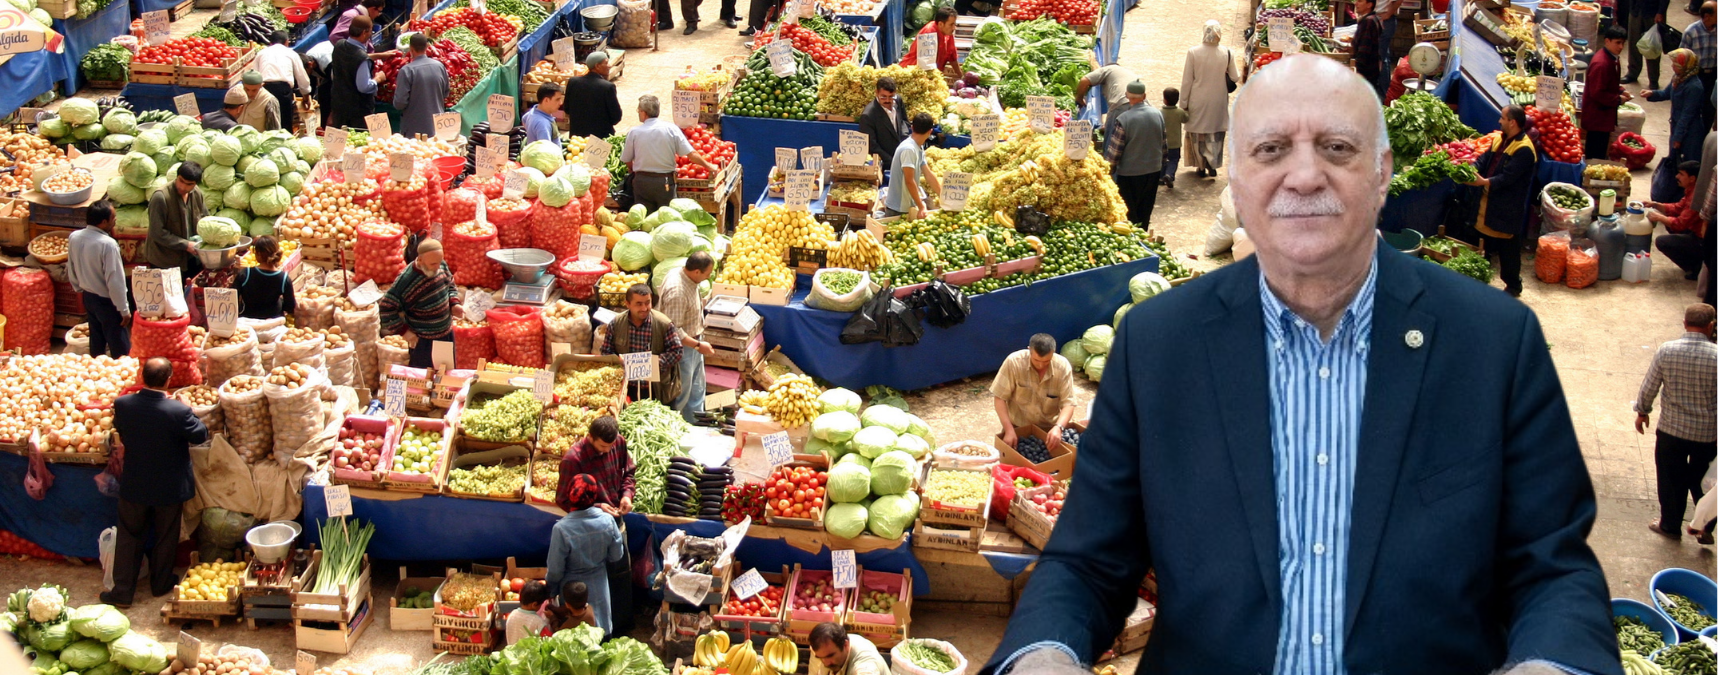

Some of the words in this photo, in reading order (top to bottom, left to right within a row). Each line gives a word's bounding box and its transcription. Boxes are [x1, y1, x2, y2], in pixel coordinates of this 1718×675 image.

[674, 103, 696, 113] 350
[490, 108, 512, 121] 750
[436, 117, 456, 129] 500
[974, 133, 995, 142] 750
[1067, 140, 1088, 149] 750
[585, 144, 609, 159] 400
[841, 146, 863, 156] 500
[390, 160, 412, 170] 400
[787, 189, 810, 199] 650
[581, 242, 588, 250] 5
[135, 281, 163, 304] 350
[206, 301, 237, 324] 400
[386, 394, 405, 413] 750
[832, 565, 855, 584] 750
[180, 634, 197, 651] 500
[298, 652, 315, 664] 500
